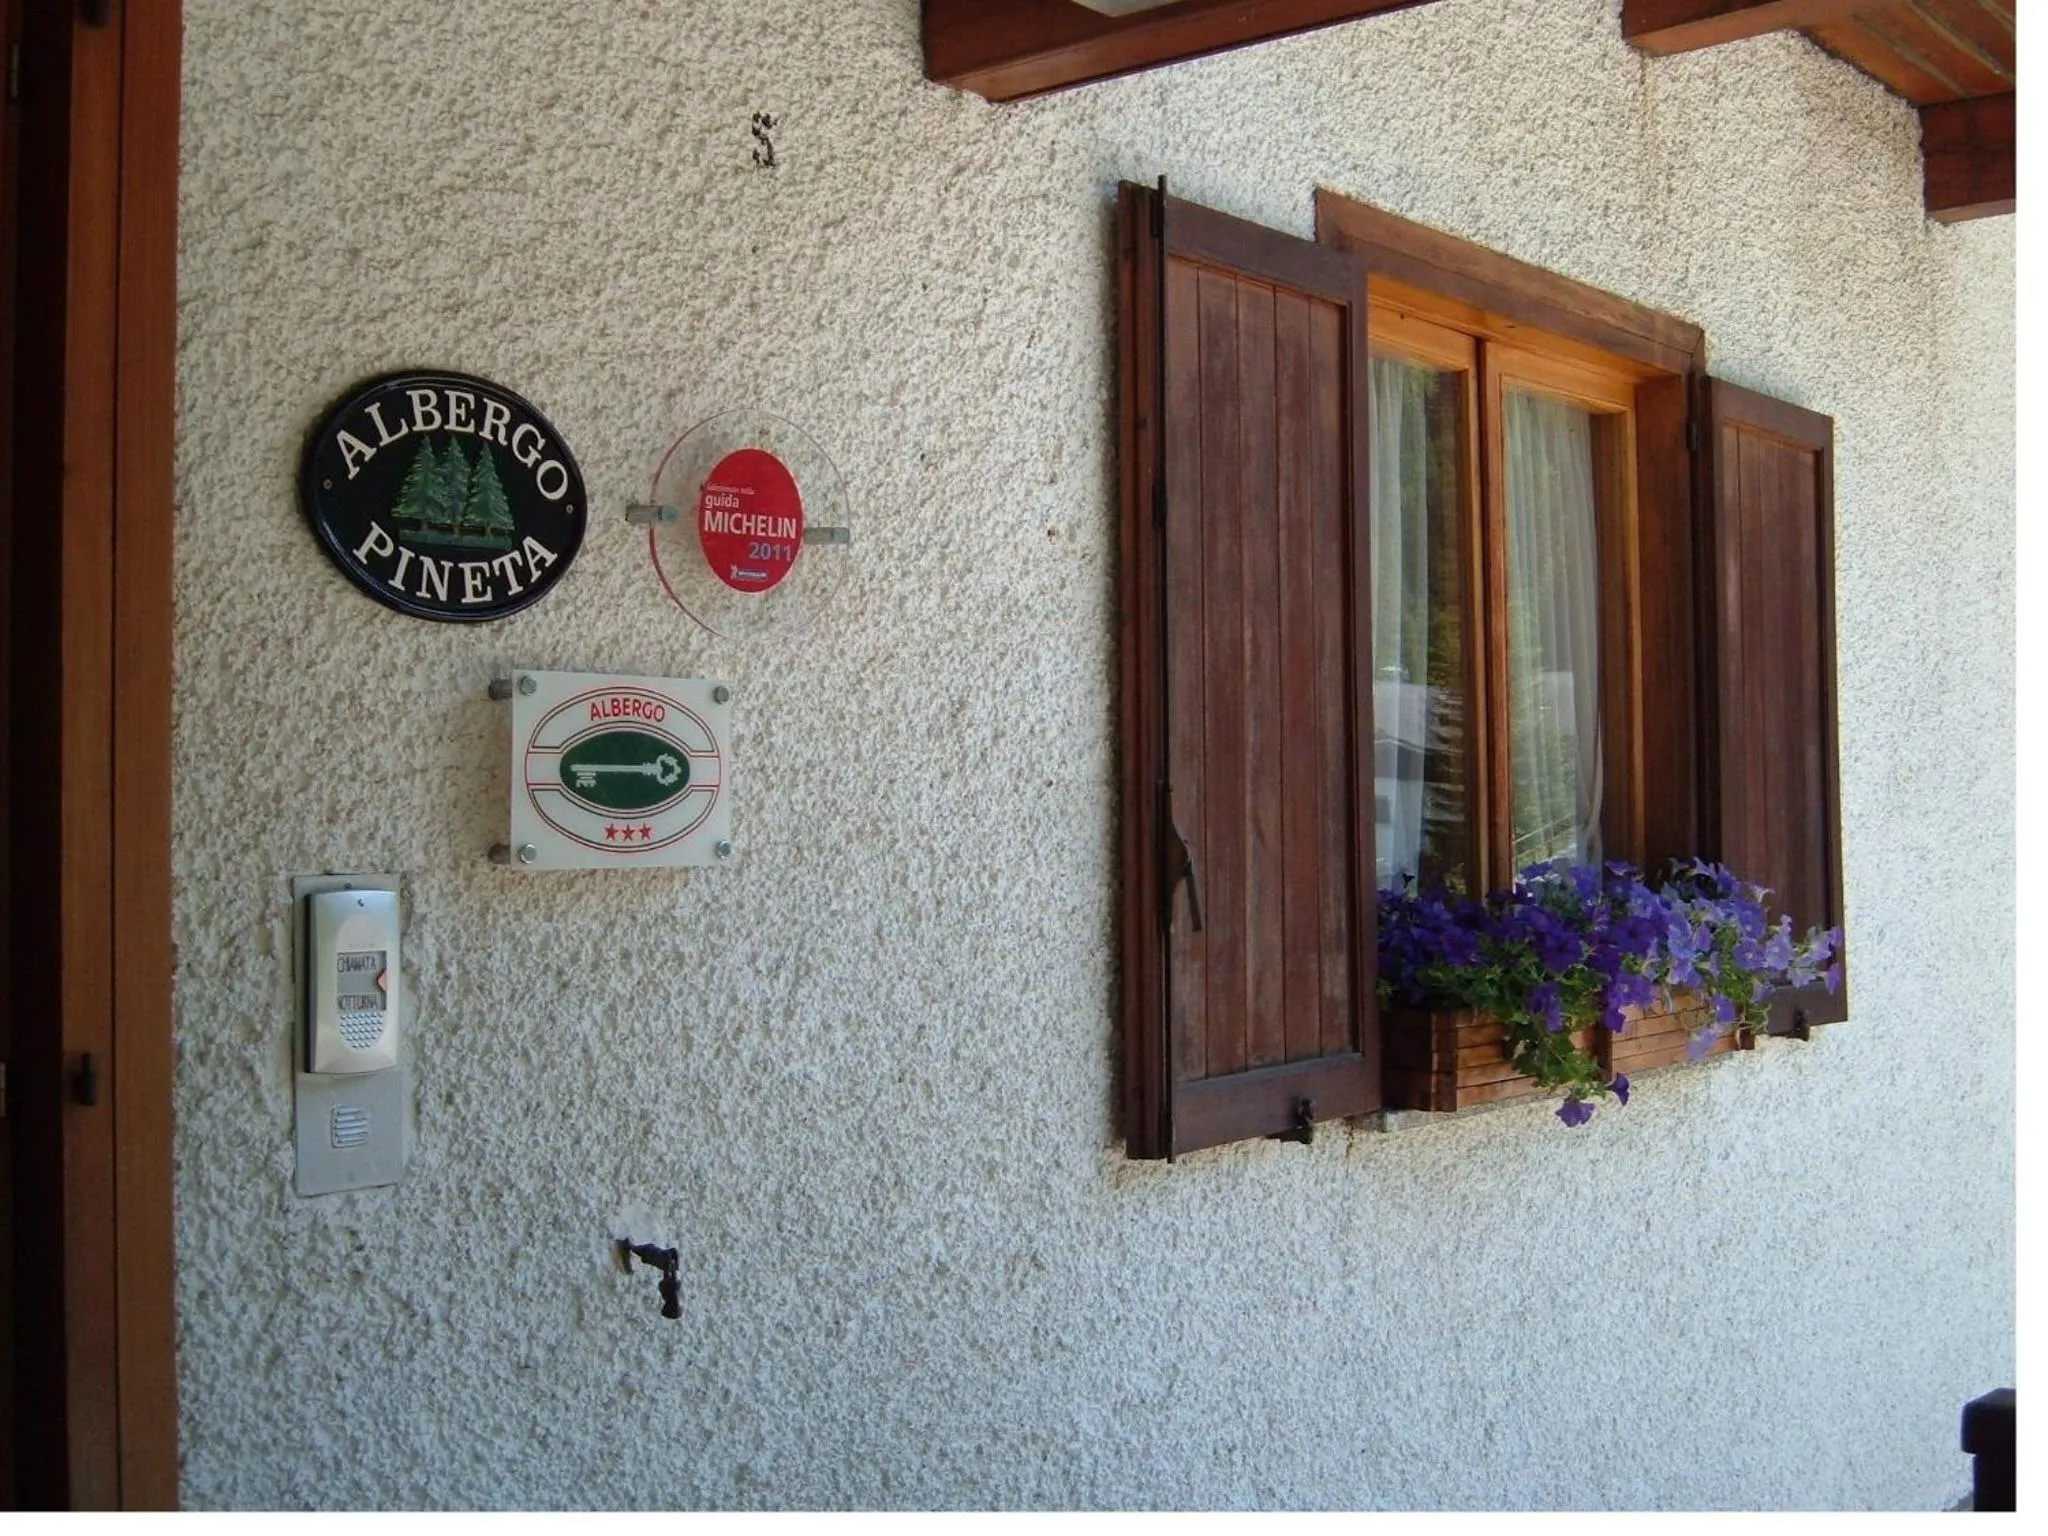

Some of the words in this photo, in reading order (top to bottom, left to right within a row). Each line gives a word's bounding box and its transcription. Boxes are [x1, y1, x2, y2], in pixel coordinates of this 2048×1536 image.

[336, 388, 568, 500] ALBERGO
[705, 493, 740, 509] guida
[704, 510, 797, 539] MICHELIN
[352, 521, 557, 603] PINETA
[749, 541, 792, 561] 2011
[590, 697, 666, 723] ALBERGO
